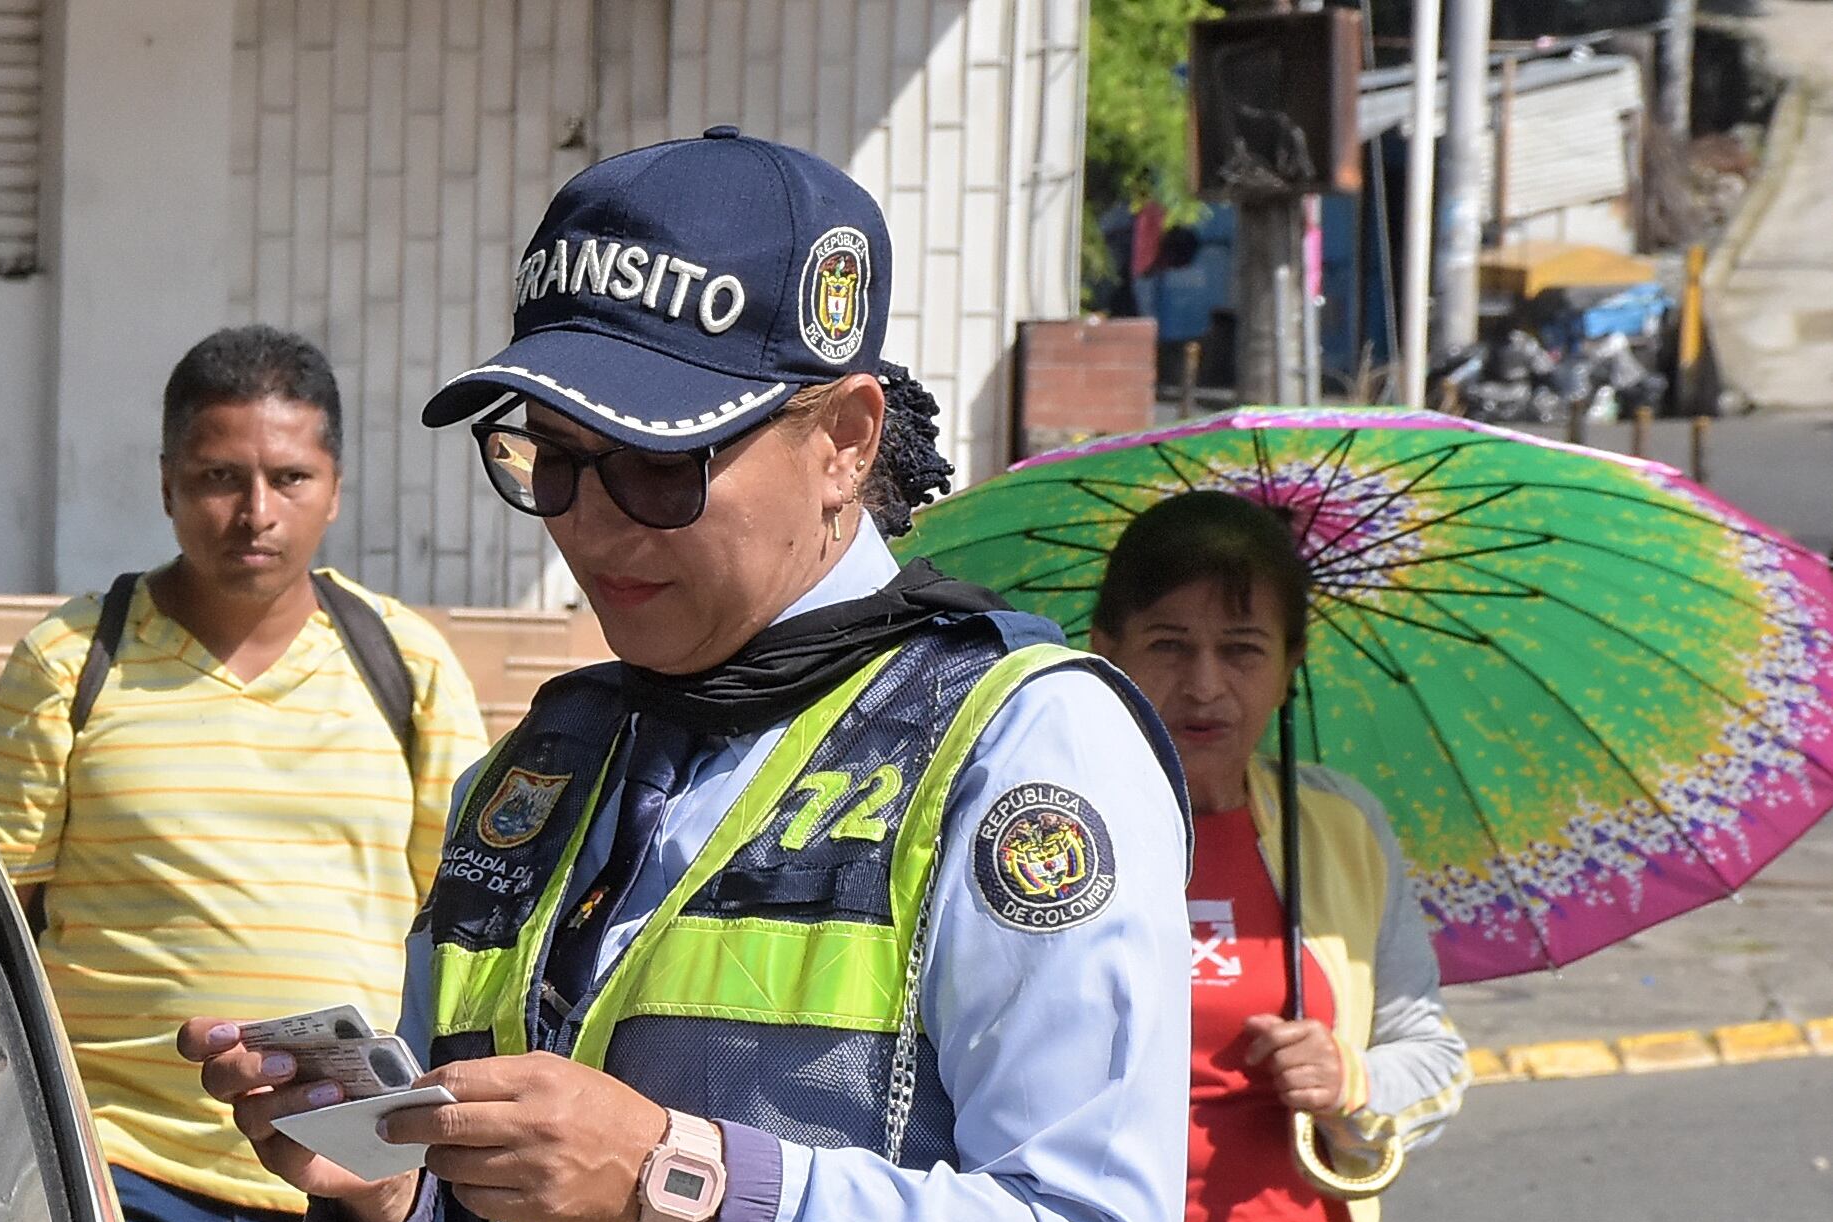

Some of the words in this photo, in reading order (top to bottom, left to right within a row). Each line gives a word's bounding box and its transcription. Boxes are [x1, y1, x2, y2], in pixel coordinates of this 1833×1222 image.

[513, 238, 746, 334] TRANSITO
[805, 322, 822, 345] DE
[779, 763, 904, 851] 72
[487, 875, 513, 894] DE
[1001, 900, 1029, 923] DE
[1030, 872, 1114, 925] COLOMBIA
